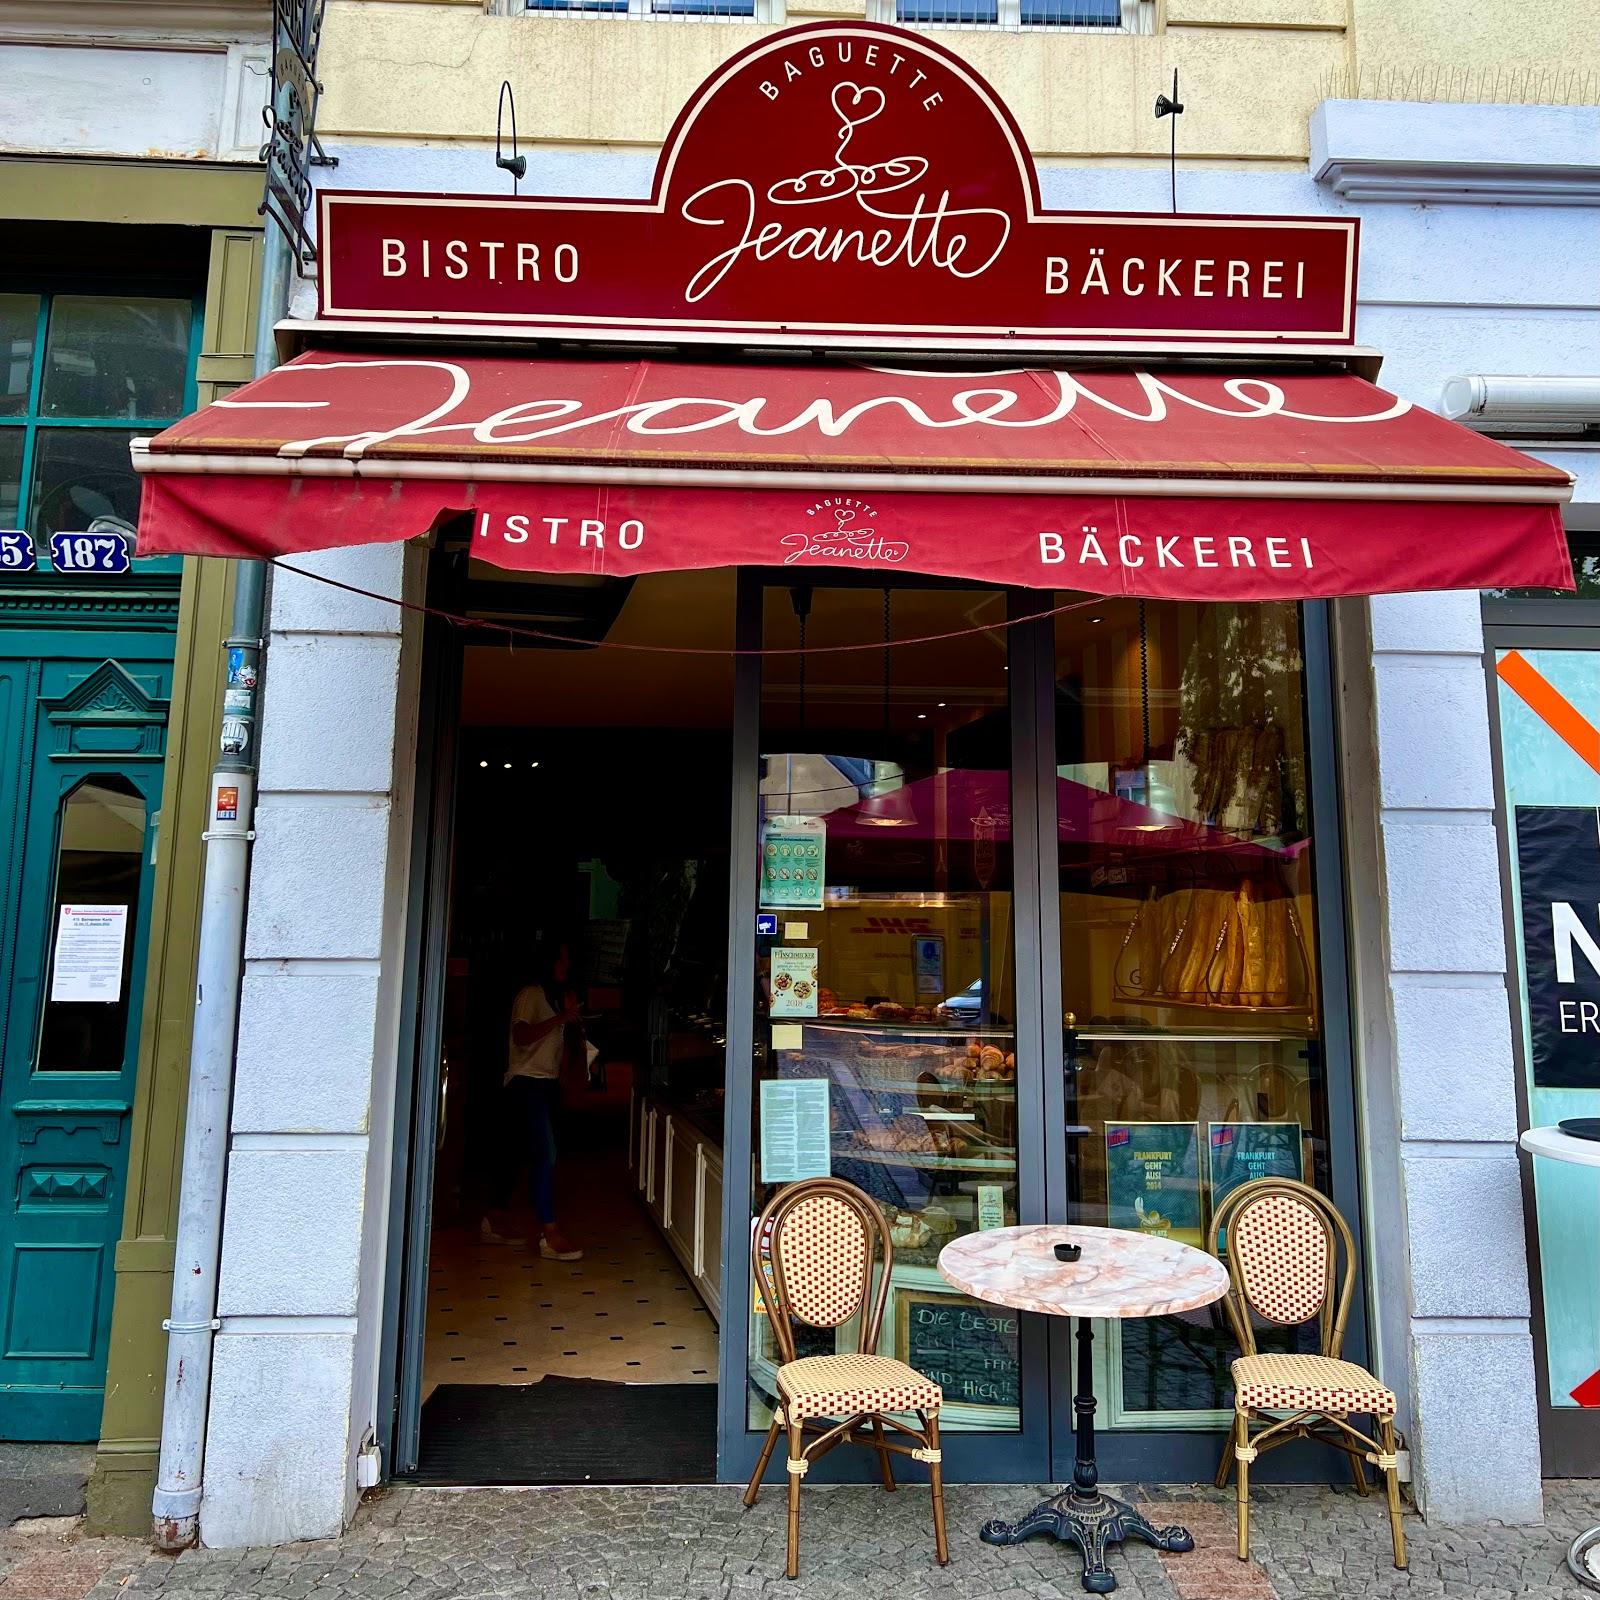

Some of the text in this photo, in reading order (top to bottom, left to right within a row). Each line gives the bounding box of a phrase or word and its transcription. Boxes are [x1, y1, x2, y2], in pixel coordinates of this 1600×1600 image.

[759, 41, 943, 111] BAGUETTE
[681, 178, 1011, 303] Jeanette
[382, 238, 578, 283] BISTRO
[1045, 248, 1304, 299] BÄCKEREI
[806, 497, 878, 518] BAGUETTE
[0, 536, 23, 566] 5
[60, 538, 116, 568] 187
[780, 533, 909, 564] Jeanette
[1039, 526, 1313, 568] BÄCKEREI
[1134, 1151, 1172, 1161] FRANKFURT
[1144, 1161, 1162, 1170] GEHT
[1237, 1152, 1275, 1161] FRANKFURT
[1248, 1162, 1266, 1170] GEHT
[917, 1309, 951, 1325] DIE
